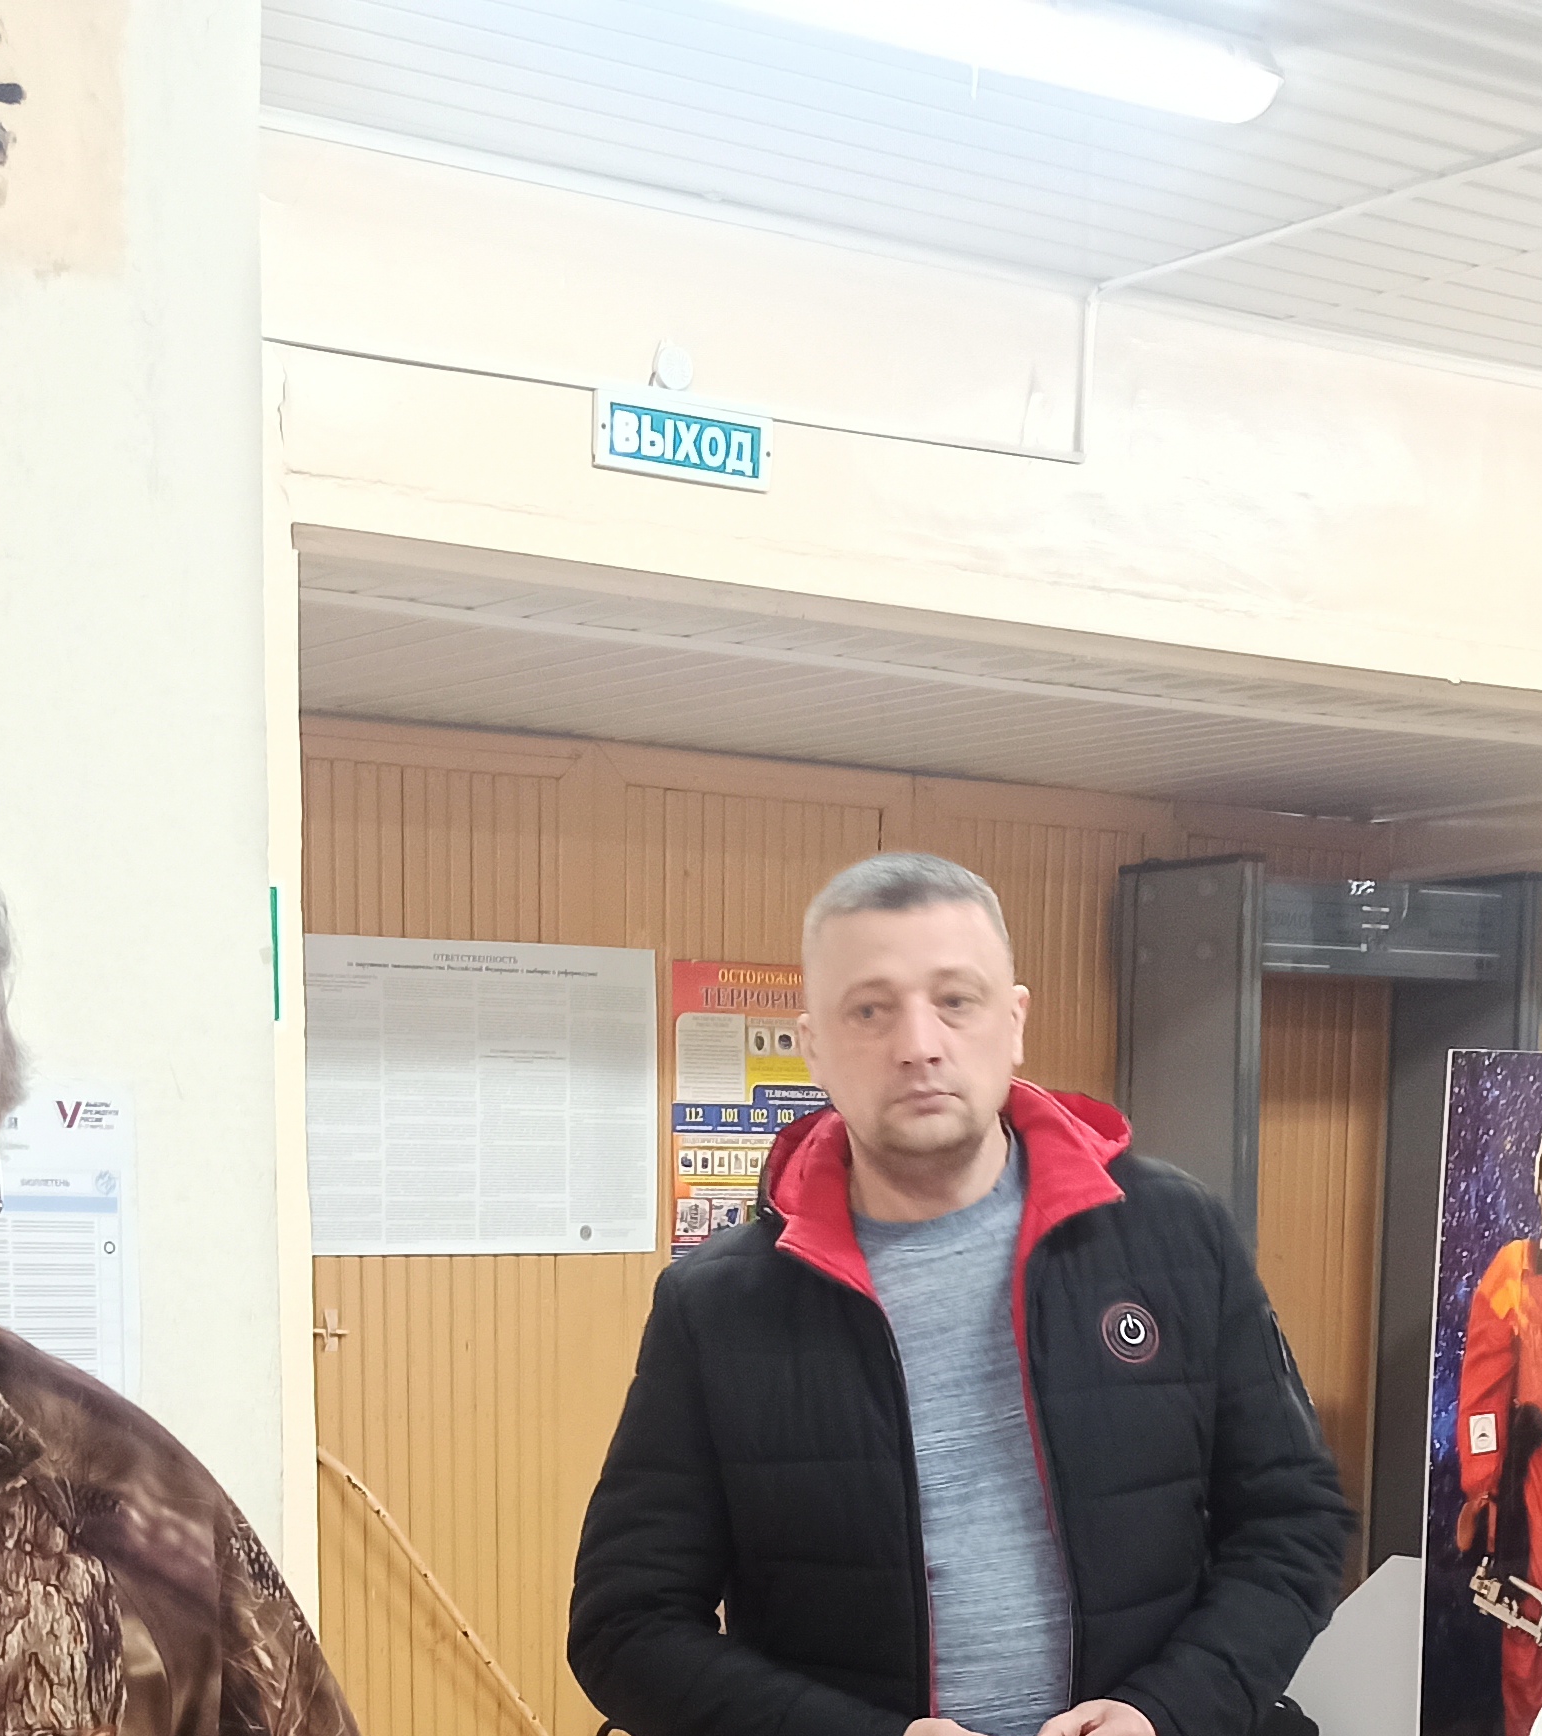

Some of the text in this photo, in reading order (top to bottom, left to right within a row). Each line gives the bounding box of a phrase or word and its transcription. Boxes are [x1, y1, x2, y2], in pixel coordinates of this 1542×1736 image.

[612, 409, 754, 477] ВЫХОД
[718, 968, 803, 986] ОСТОРОЖН
[700, 986, 802, 1010] ТЕРРОРИ
[685, 1107, 703, 1122] 112
[720, 1108, 739, 1123] 101
[750, 1108, 768, 1123] 102
[777, 1108, 794, 1123] 103
